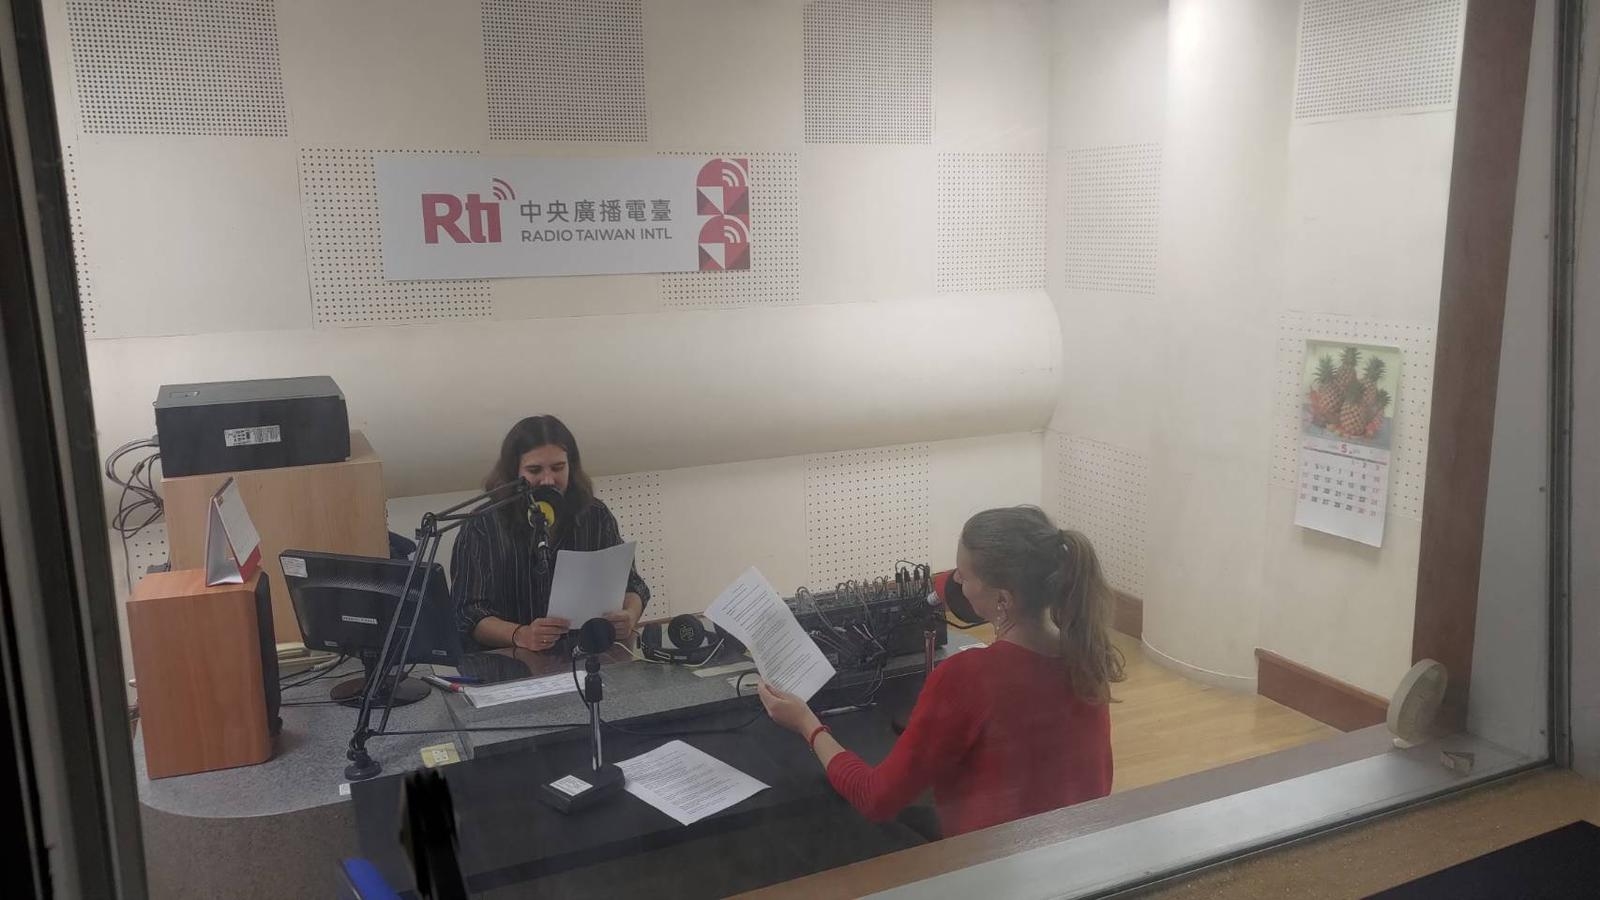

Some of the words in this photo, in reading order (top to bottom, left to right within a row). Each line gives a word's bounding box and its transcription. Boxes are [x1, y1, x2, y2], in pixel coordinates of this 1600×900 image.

[421, 193, 502, 244] Rti
[520, 199, 672, 223] 中央廣播電臺
[521, 229, 573, 242] RADIO
[576, 228, 636, 242] TAIWAN
[640, 228, 673, 240] INTL
